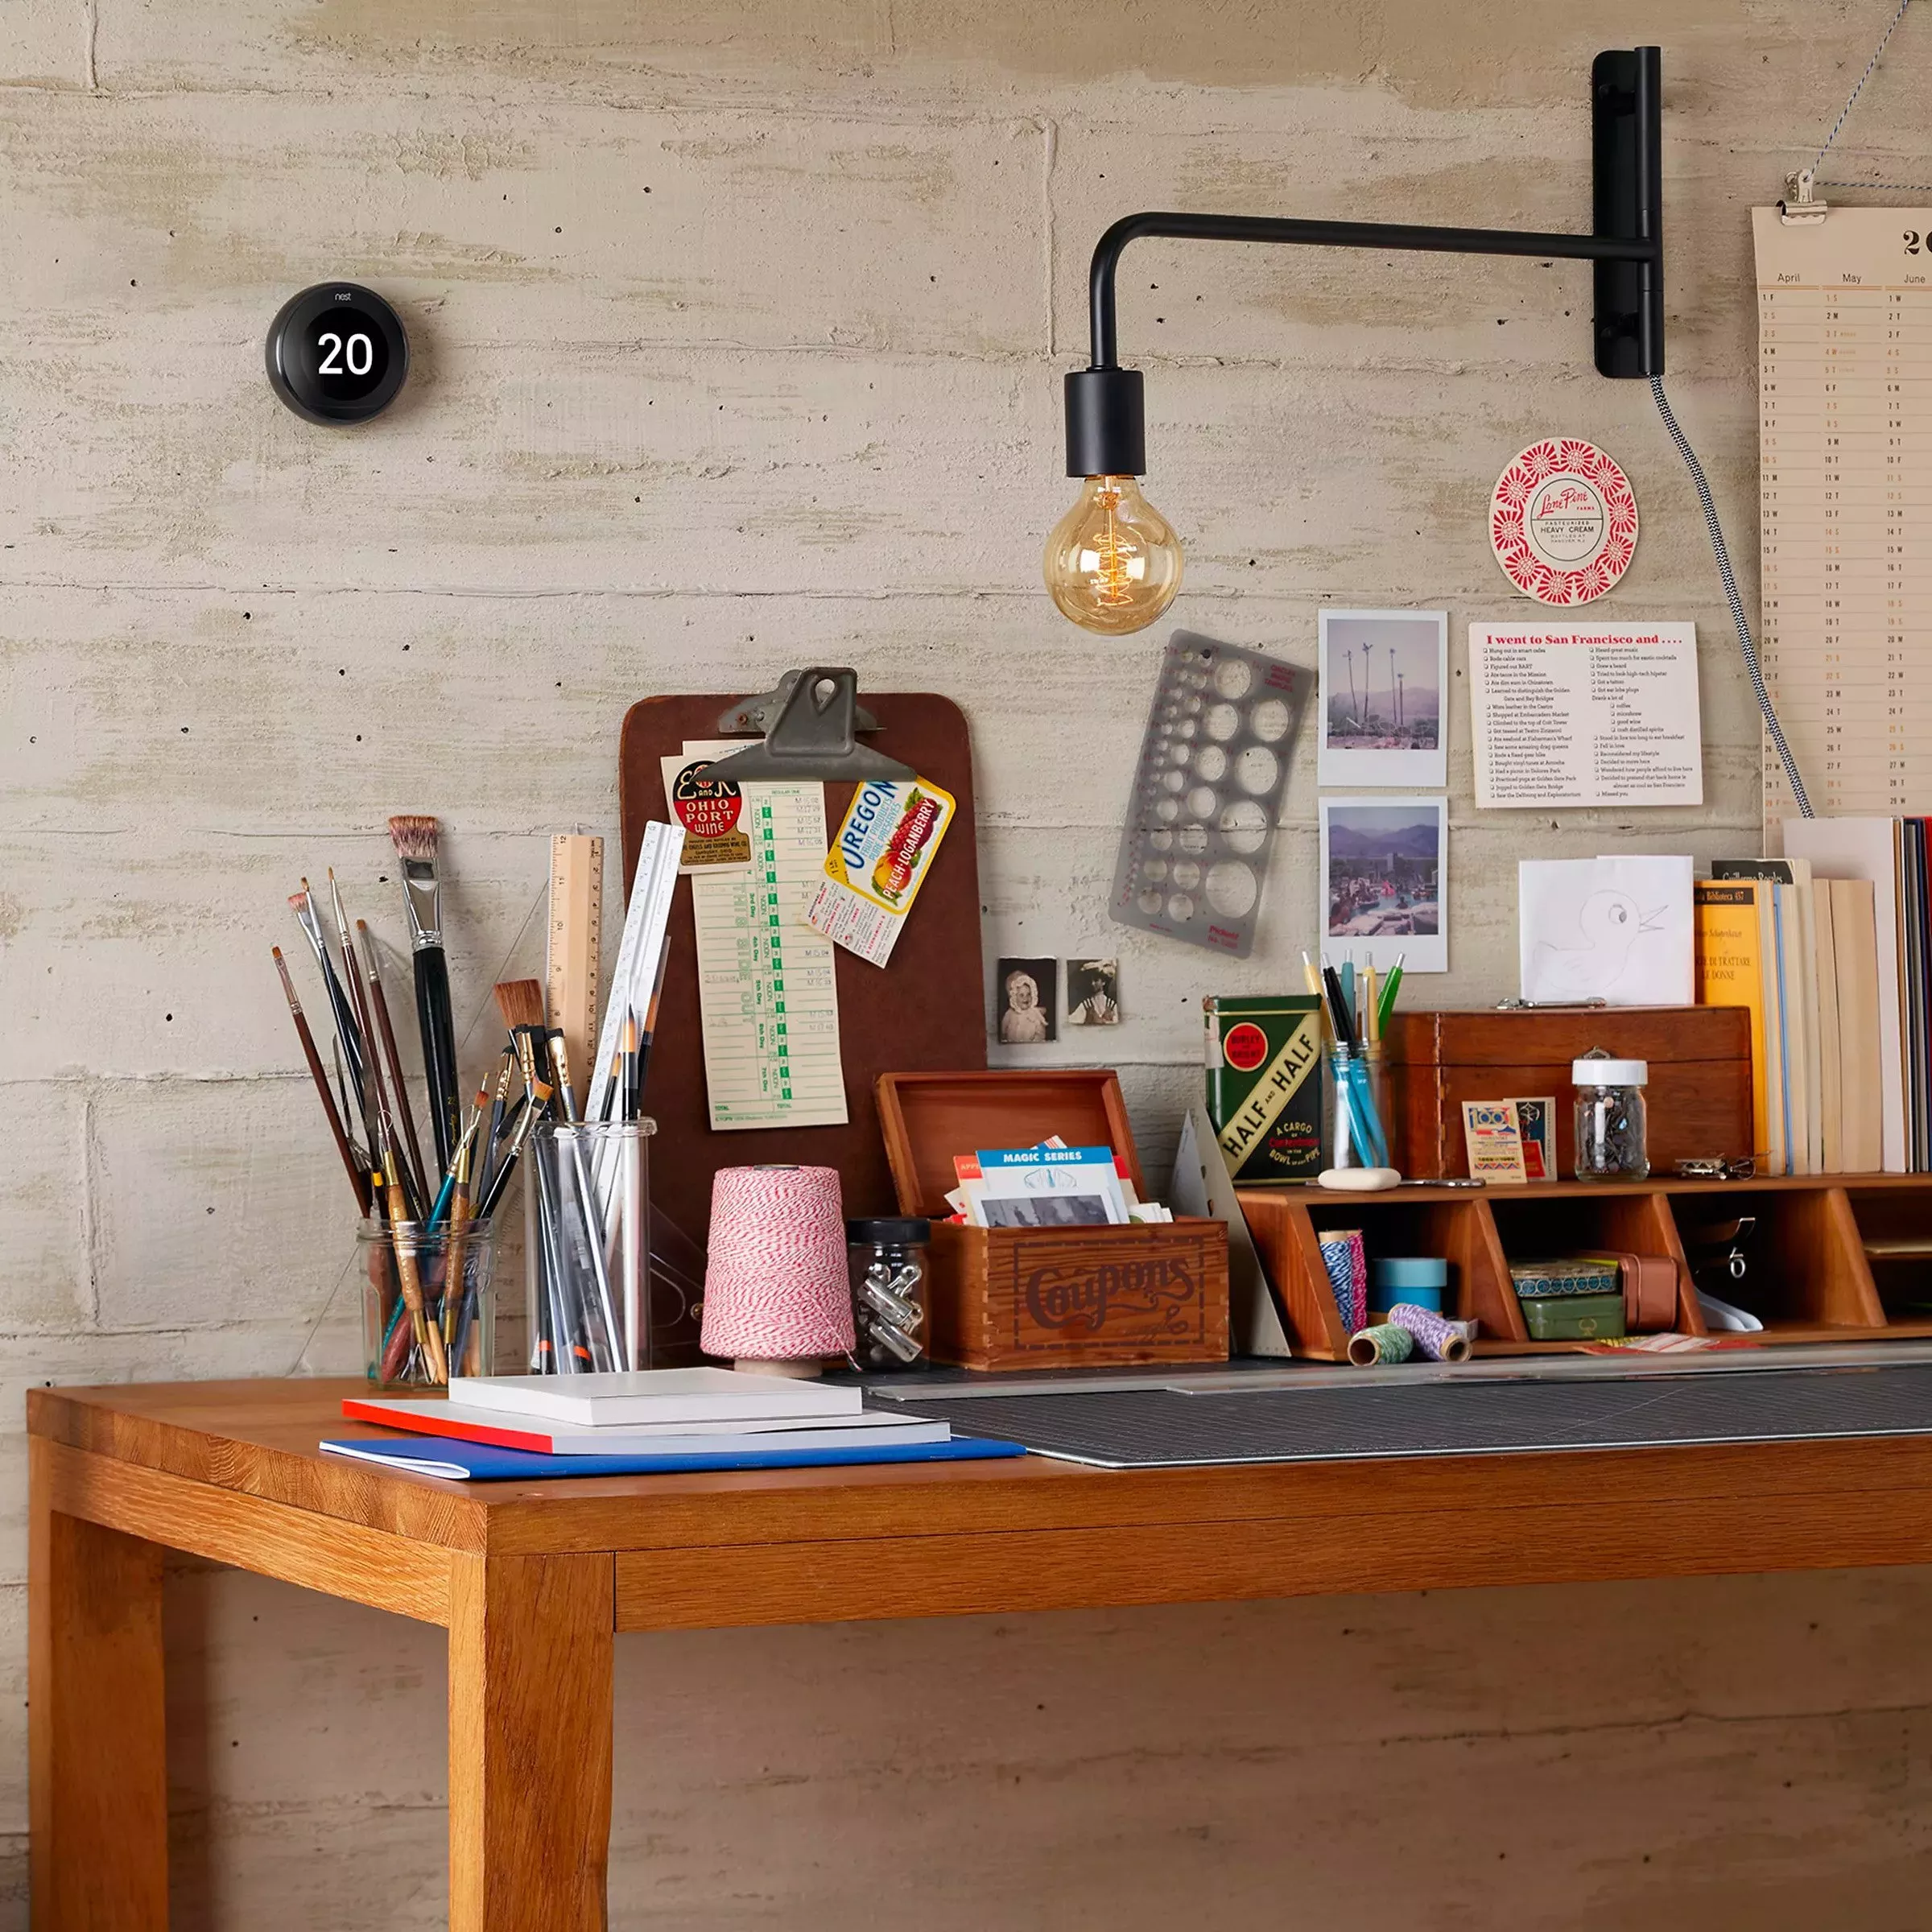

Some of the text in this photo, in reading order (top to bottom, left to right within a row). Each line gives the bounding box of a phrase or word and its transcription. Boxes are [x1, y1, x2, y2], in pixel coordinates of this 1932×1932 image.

[1777, 273, 1800, 283] April
[1843, 274, 1862, 284] May
[1904, 275, 1926, 283] June
[335, 293, 352, 301] nest
[318, 333, 373, 375] 20
[1537, 488, 1588, 519] Lone Pine
[1487, 634, 1658, 644] I went to San Francisco and
[686, 799, 729, 811] OHIO
[686, 811, 734, 824] PORT
[695, 822, 724, 835] WINE
[842, 780, 899, 869] OREGON
[861, 798, 894, 857] FRUIT PRODUCTS
[869, 803, 902, 862] PURE PRESERVES
[560, 836, 566, 844] 12
[1707, 891, 1732, 901] Biblioteca
[1709, 957, 1717, 965] DI
[1719, 956, 1750, 966] TRATTARE
[1712, 971, 1735, 980] DONNE
[1222, 1100, 1267, 1158] HALF
[1264, 1091, 1276, 1104] AND
[1270, 1033, 1315, 1092] HALF
[1276, 1122, 1312, 1136] A CARGO
[1004, 1151, 1082, 1162] MAGIC SERIES
[1269, 1147, 1320, 1165] BOWL PIPE
[1025, 1257, 1195, 1331] Coupons
